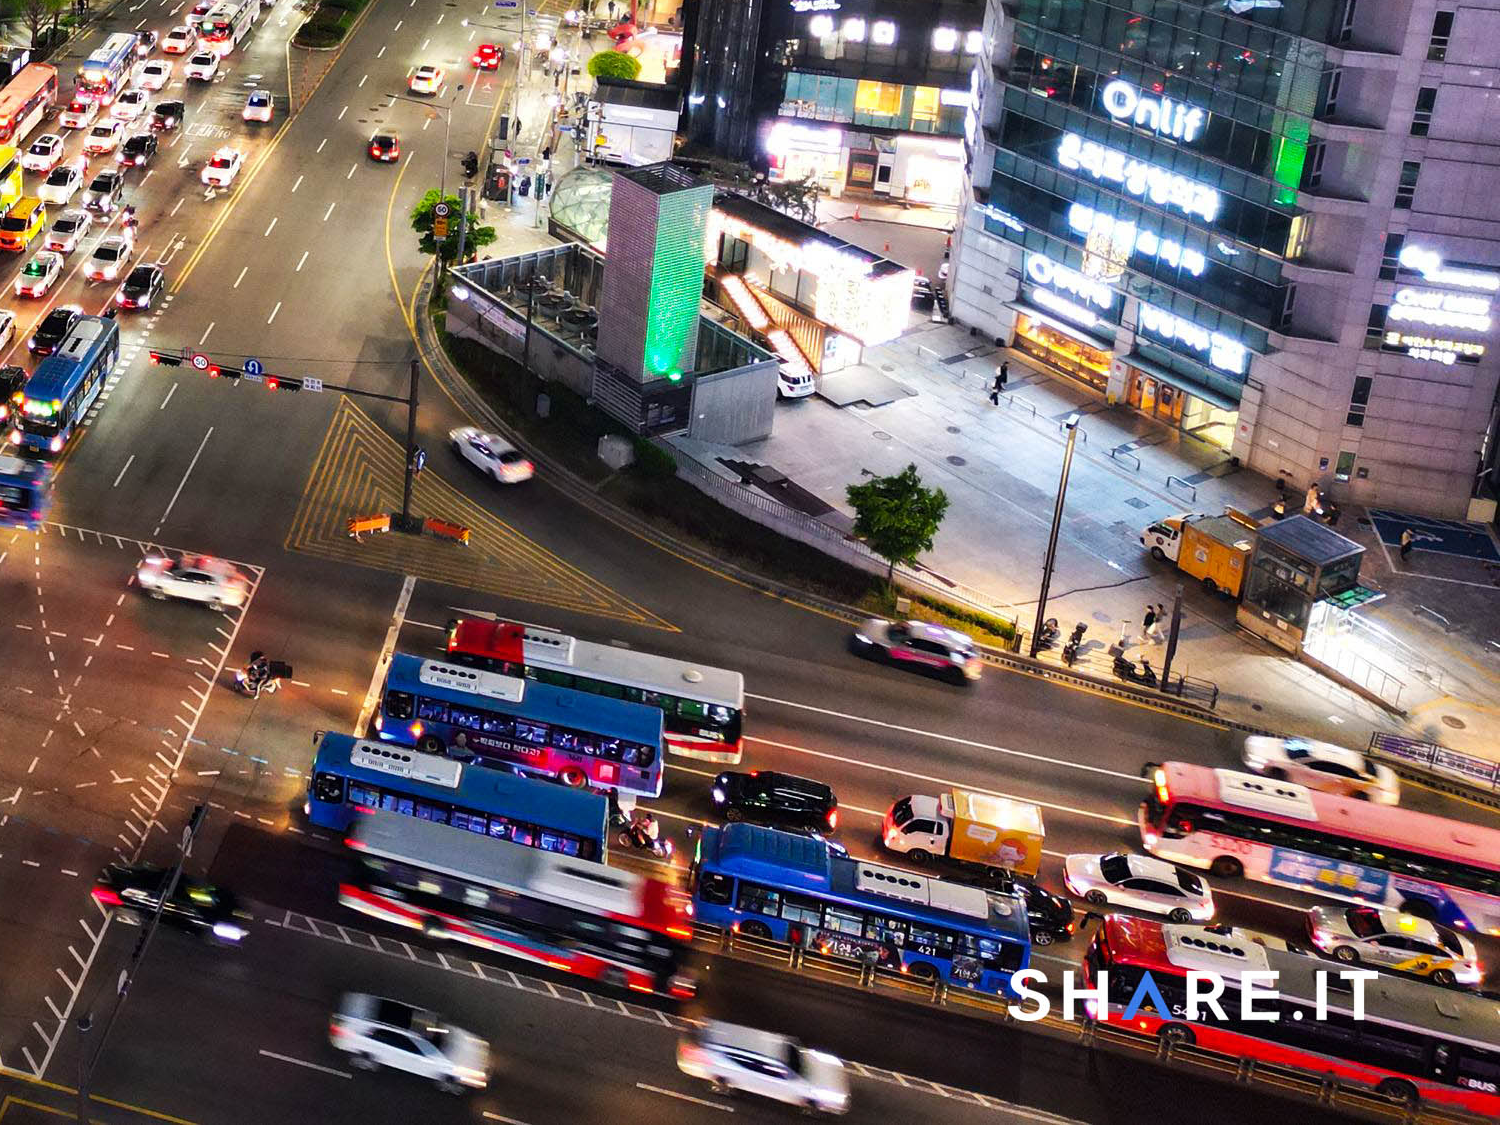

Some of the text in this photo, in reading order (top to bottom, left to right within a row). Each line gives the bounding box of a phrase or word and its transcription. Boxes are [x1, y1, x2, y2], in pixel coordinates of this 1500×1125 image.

[1102, 79, 1208, 142] Onlif
[195, 358, 206, 366] 50
[917, 945, 937, 956] 421
